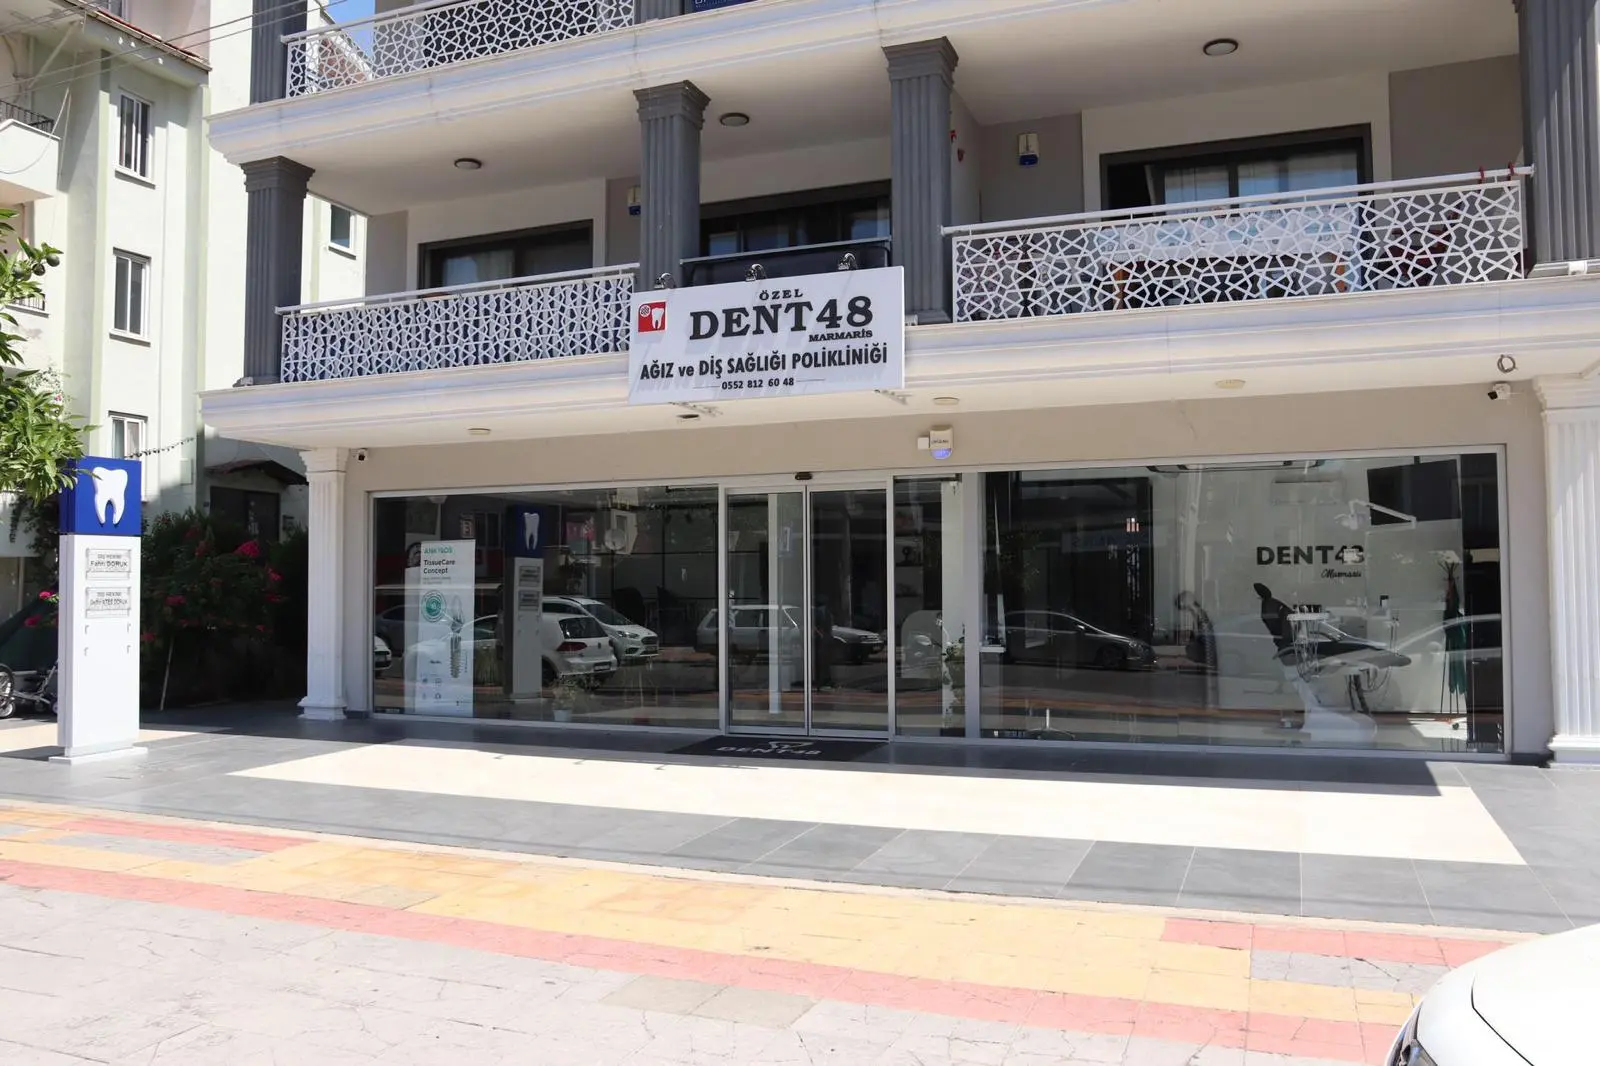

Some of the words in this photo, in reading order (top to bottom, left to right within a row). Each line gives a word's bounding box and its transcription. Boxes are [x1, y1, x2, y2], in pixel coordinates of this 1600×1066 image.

[758, 288, 803, 301] ÖZEL
[689, 295, 874, 341] DENT48
[808, 328, 873, 343] MARMARİS
[640, 359, 674, 381] AĞIZ
[678, 365, 695, 377] ve
[699, 354, 723, 379] DİŞ
[727, 350, 786, 374] SAĞLIĞI
[791, 342, 888, 370] POLİKLİNİĞİ
[721, 379, 744, 390] 0552
[747, 378, 763, 389] 812
[767, 377, 780, 388] 60
[782, 376, 794, 387] 48
[423, 567, 448, 575] Concept
